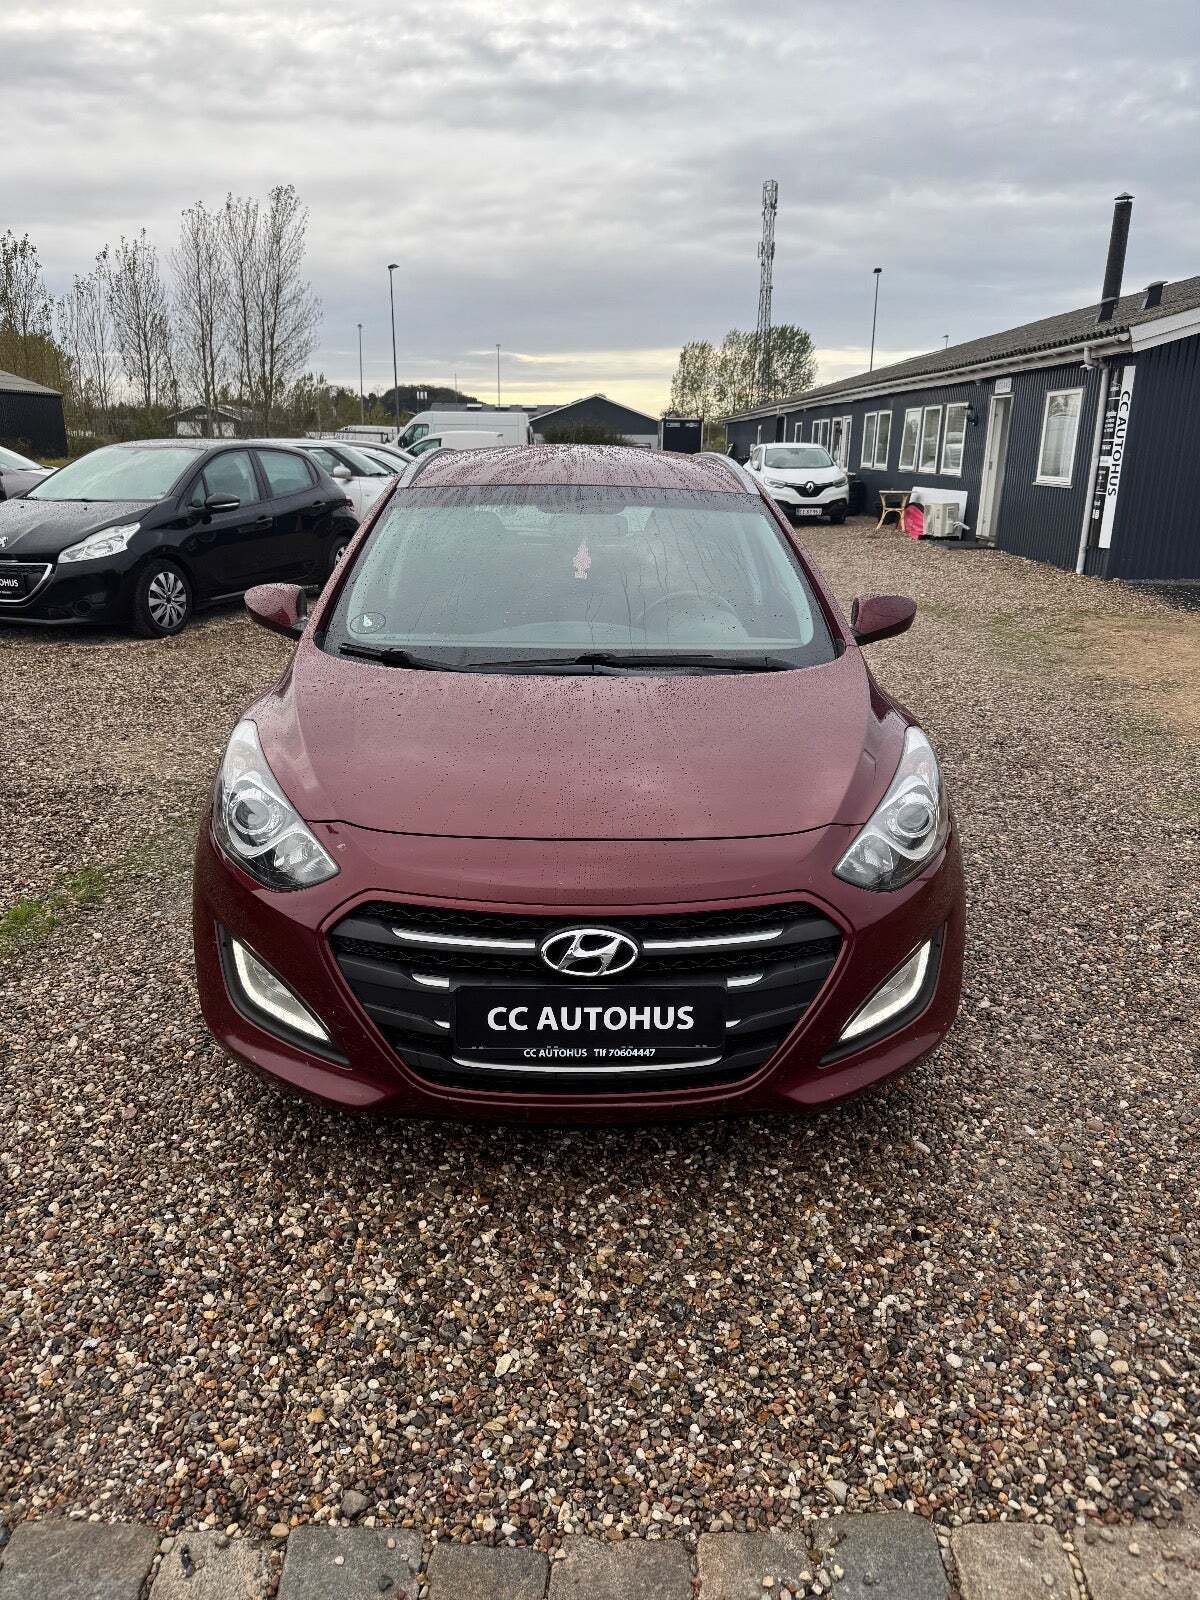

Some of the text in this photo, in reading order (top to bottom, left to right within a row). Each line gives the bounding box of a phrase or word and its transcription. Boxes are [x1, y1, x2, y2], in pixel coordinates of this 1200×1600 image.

[1119, 390, 1131, 412] CC
[1107, 416, 1127, 497] AUTOHUS
[487, 1005, 695, 1031] CC AUTOHUS
[523, 1048, 537, 1058] CC
[538, 1048, 588, 1058] AUTOHUS
[608, 1048, 656, 1058] 70604447
